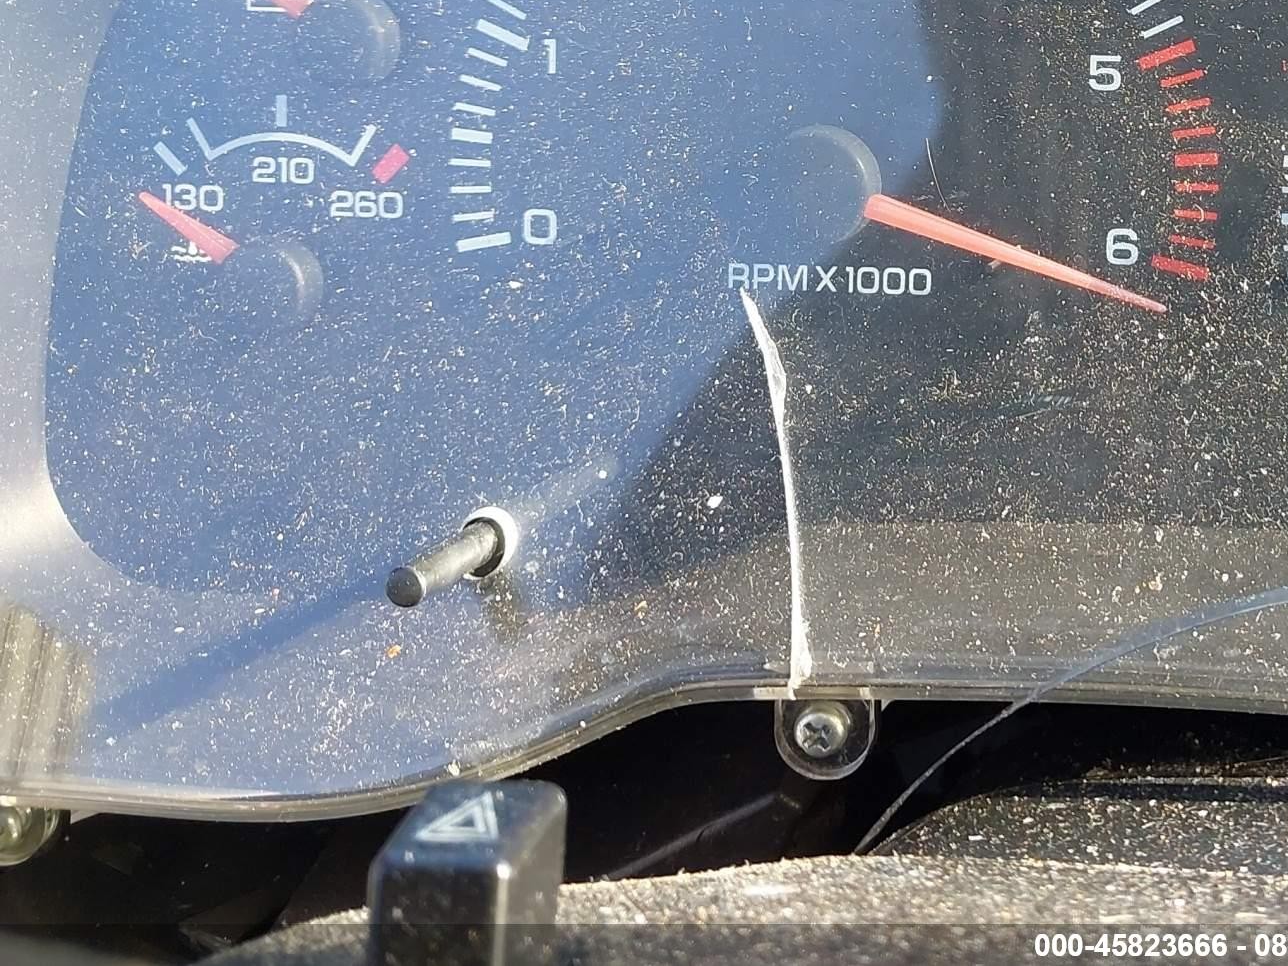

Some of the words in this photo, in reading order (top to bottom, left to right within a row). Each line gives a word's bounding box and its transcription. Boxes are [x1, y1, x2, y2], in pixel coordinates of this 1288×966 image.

[544, 38, 559, 74] 1
[1088, 54, 1123, 92] 5
[252, 157, 315, 184] 210
[162, 184, 224, 212] 130
[329, 191, 404, 219] 260
[523, 210, 558, 246] 0
[1107, 230, 1139, 266] 6
[728, 262, 808, 292] RPM
